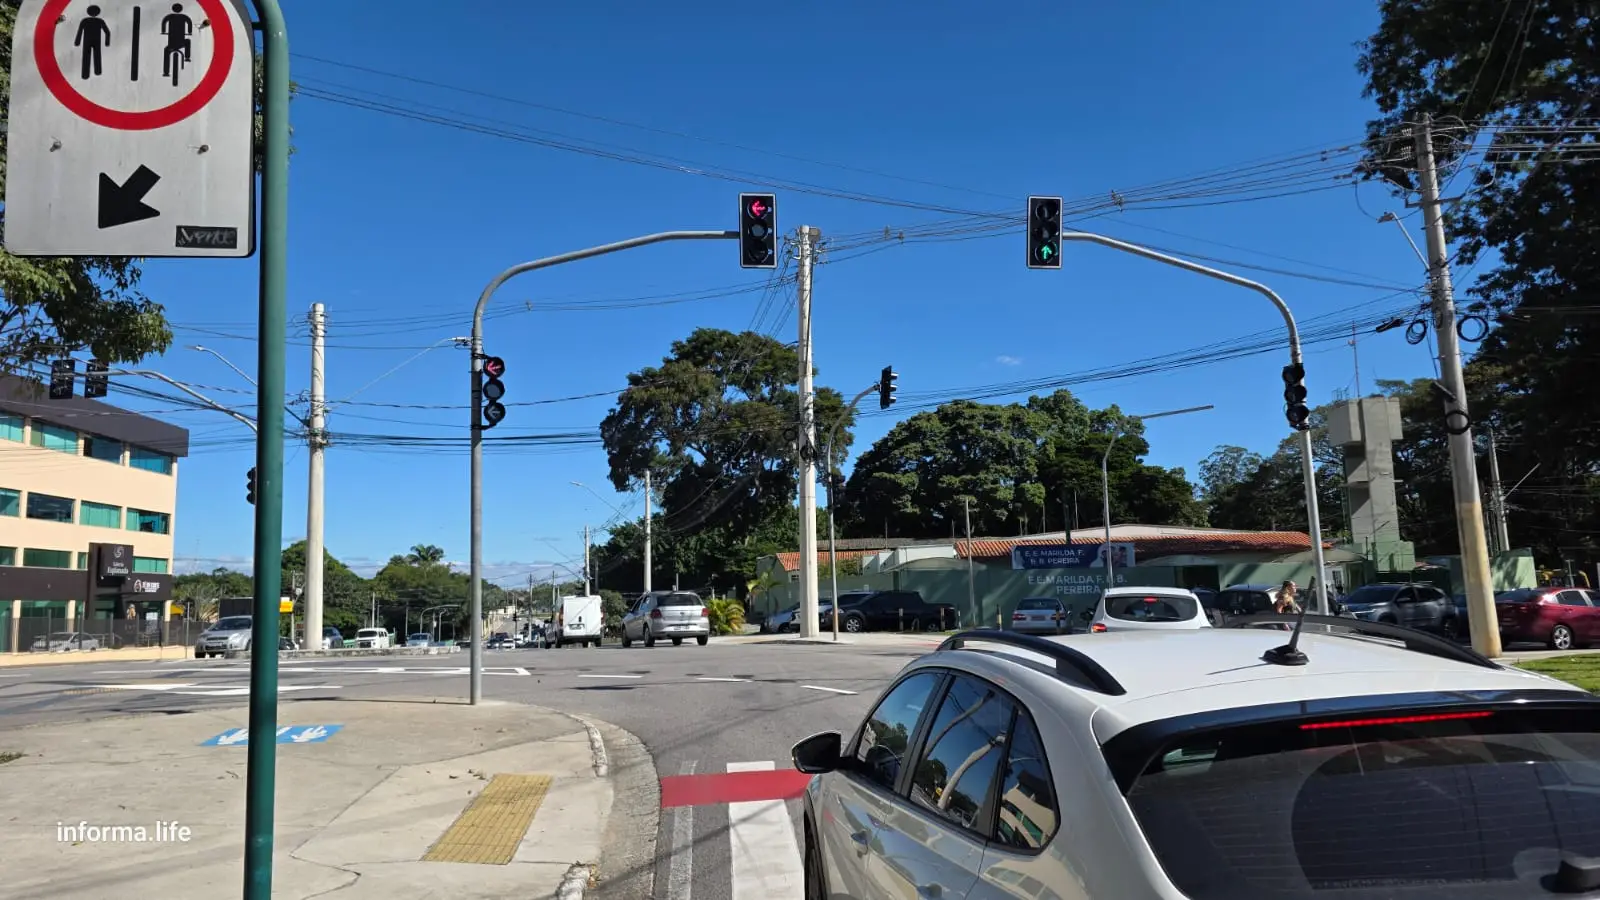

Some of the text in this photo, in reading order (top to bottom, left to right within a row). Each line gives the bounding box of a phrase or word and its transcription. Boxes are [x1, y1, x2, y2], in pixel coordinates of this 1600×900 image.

[1041, 549, 1076, 557] MARILDA
[1047, 557, 1081, 565] PEREIRA
[1056, 585, 1101, 595] PEREIRA
